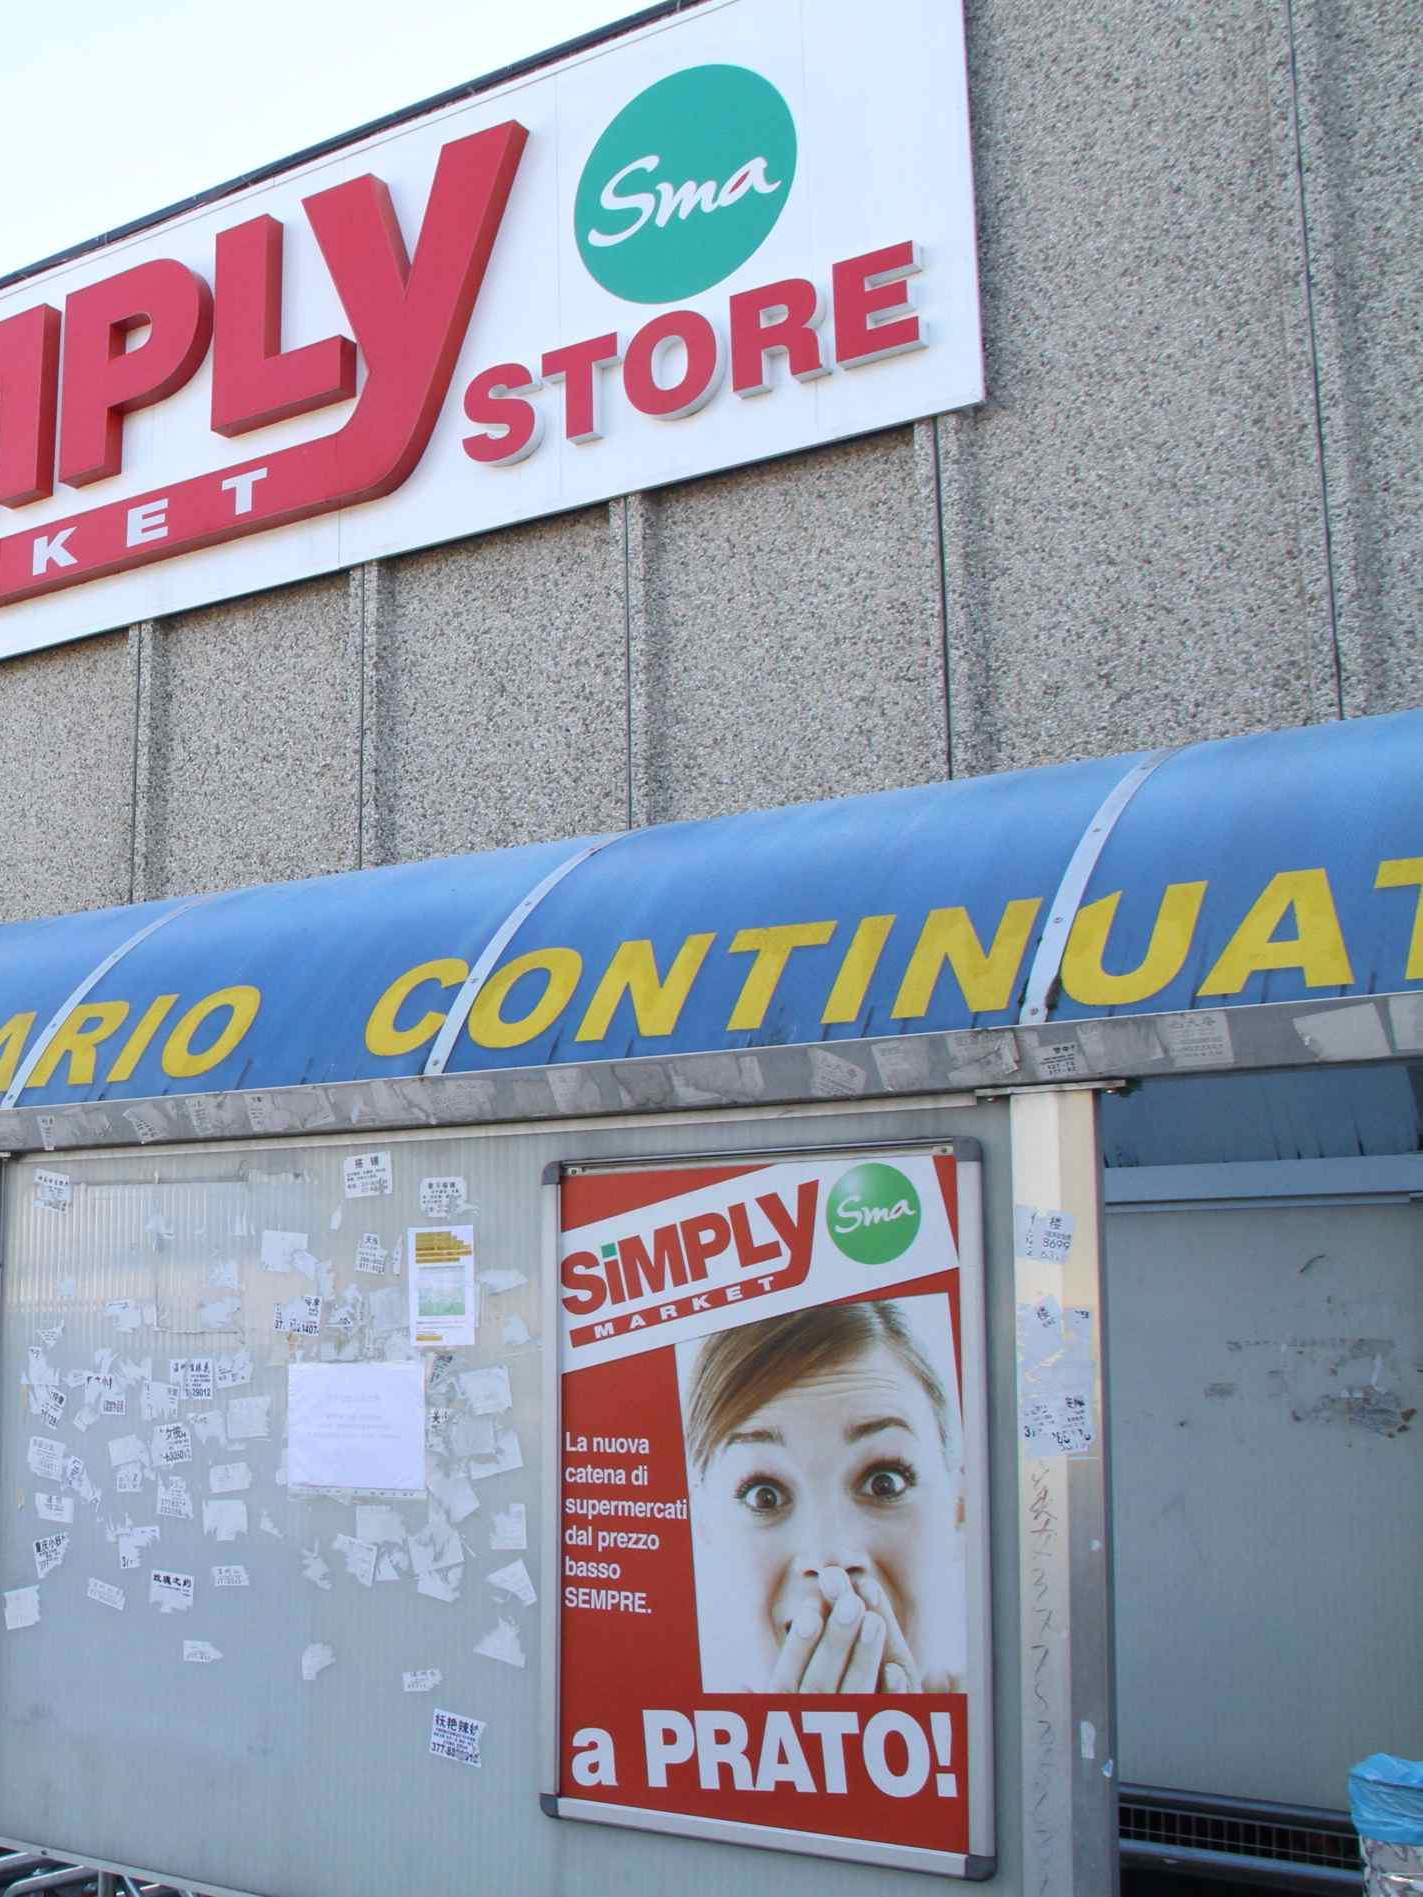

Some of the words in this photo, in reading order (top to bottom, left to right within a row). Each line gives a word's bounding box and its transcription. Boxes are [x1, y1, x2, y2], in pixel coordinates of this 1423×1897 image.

[587, 154, 782, 247] Sma
[462, 239, 928, 467] STORE
[834, 1196, 915, 1233] Sma
[594, 1276, 774, 1340] MARKET
[566, 1432, 587, 1451] La
[593, 1436, 649, 1454] nuova
[565, 1465, 625, 1485] catena
[631, 1465, 648, 1485] di
[565, 1497, 687, 1520] supermercati
[565, 1525, 593, 1546] dal
[598, 1530, 660, 1552] prezzo
[565, 1556, 620, 1579] basso
[565, 1586, 652, 1614] SEMPRE.
[571, 1727, 616, 1788] a
[642, 1708, 958, 1798] PRATO!
